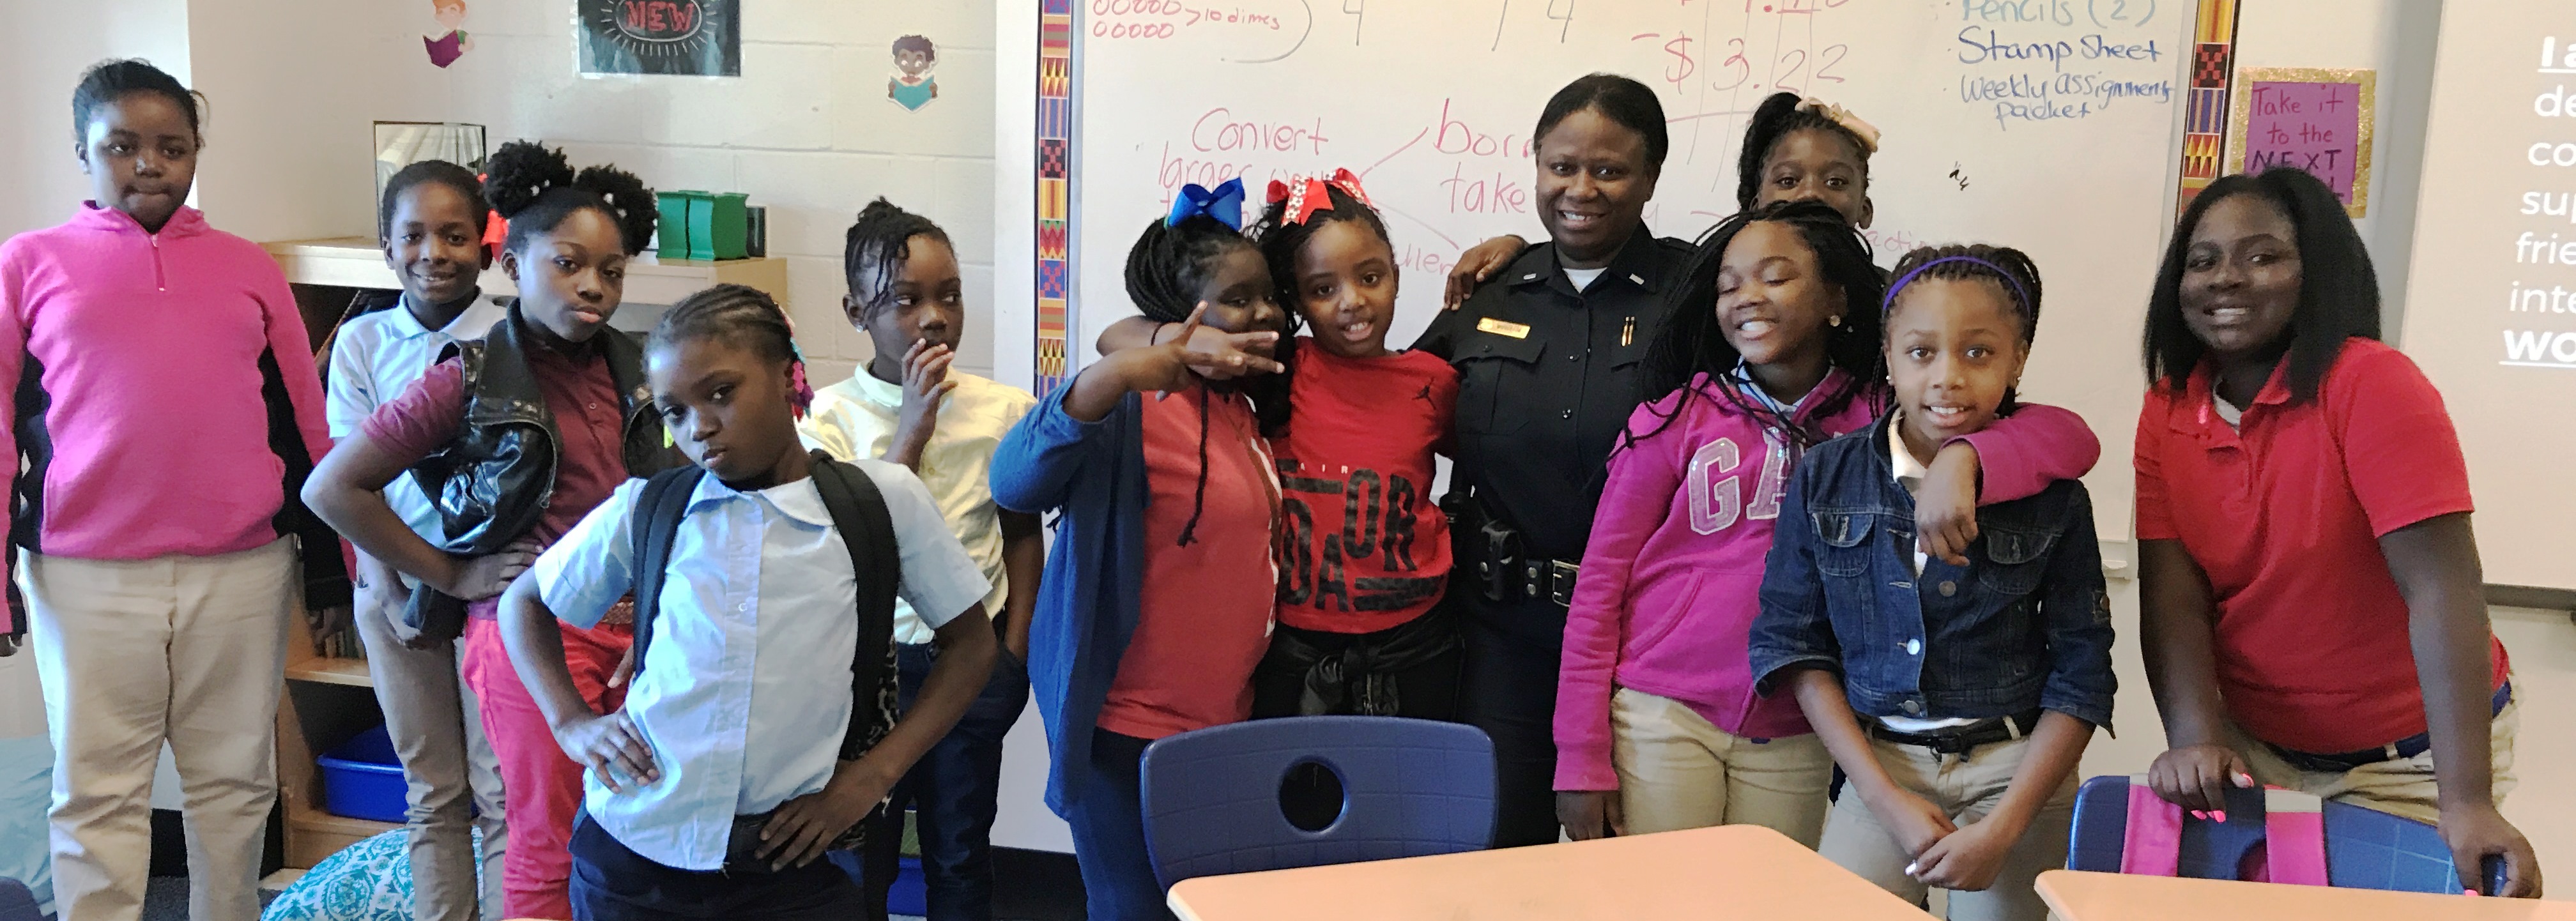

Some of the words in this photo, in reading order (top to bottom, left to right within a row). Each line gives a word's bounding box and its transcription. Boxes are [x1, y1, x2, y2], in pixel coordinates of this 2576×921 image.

[625, 1, 694, 32] NEW
[1227, 7, 1280, 30] dimes
[1958, 26, 2073, 73] Stamp
[1996, 100, 2091, 132] packet
[2252, 86, 2302, 116] Take
[2319, 84, 2344, 113] it
[1192, 107, 1329, 156] Convert
[1432, 98, 1535, 158] borr
[2267, 121, 2290, 144] to
[2299, 122, 2333, 144] the
[2251, 149, 2342, 172] NEXT
[2528, 142, 2576, 167] co
[1440, 161, 1526, 214] take
[2520, 191, 2576, 224] su
[2515, 231, 2576, 265] frie
